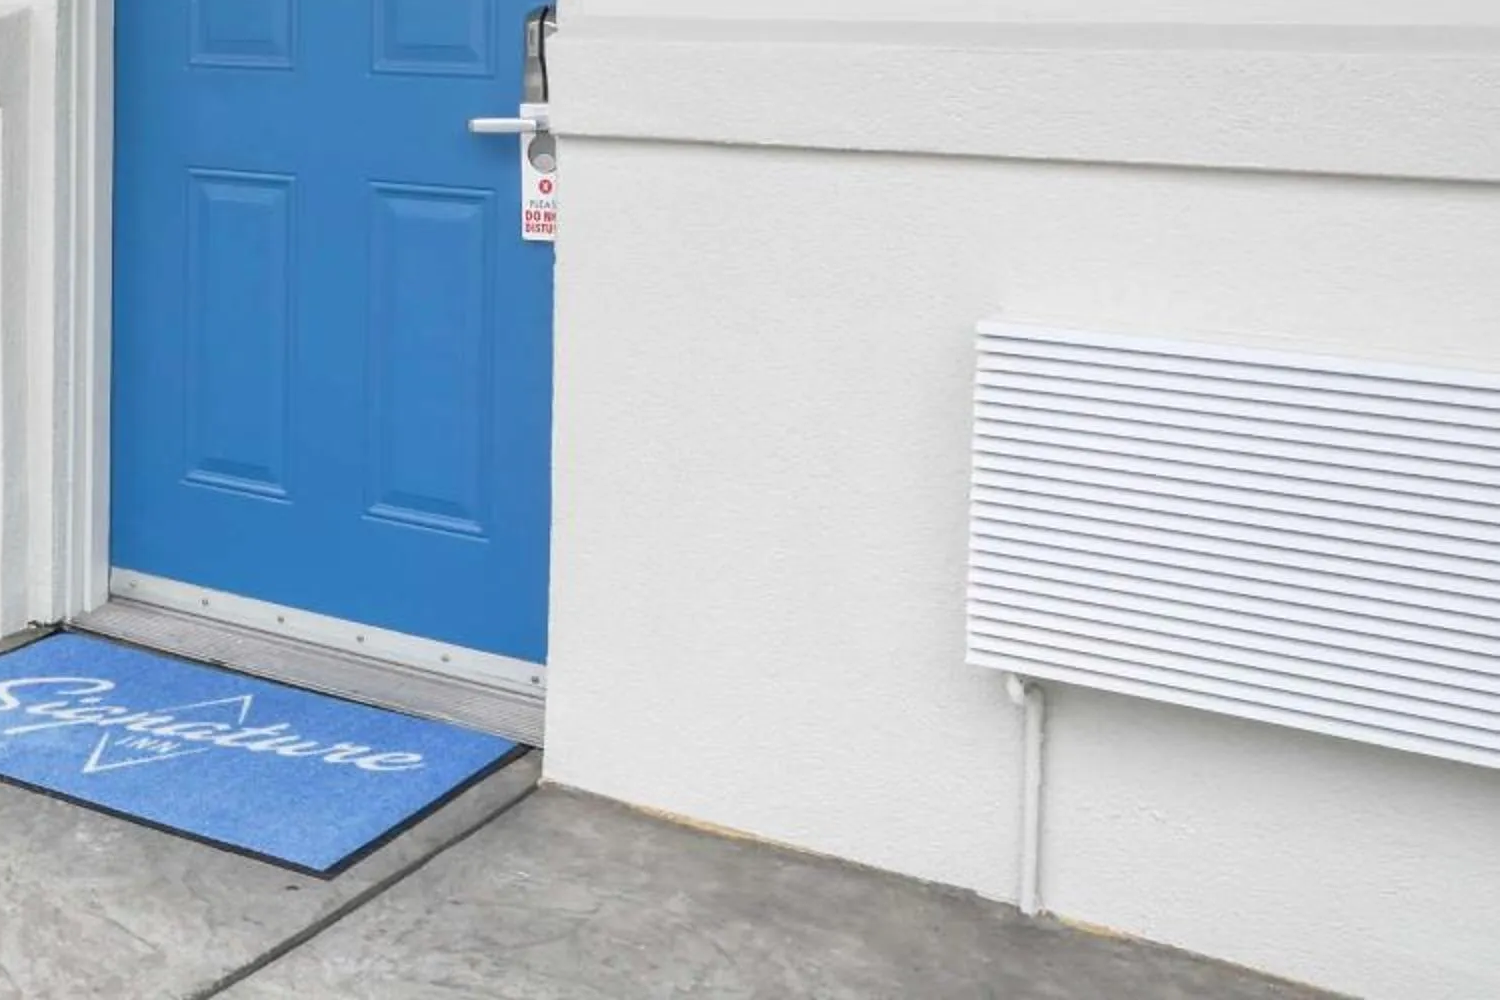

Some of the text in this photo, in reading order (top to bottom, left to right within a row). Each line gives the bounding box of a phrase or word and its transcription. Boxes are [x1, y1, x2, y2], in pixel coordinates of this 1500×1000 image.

[525, 210, 541, 222] DO
[525, 223, 557, 234] DISTU
[114, 735, 183, 753] INN
